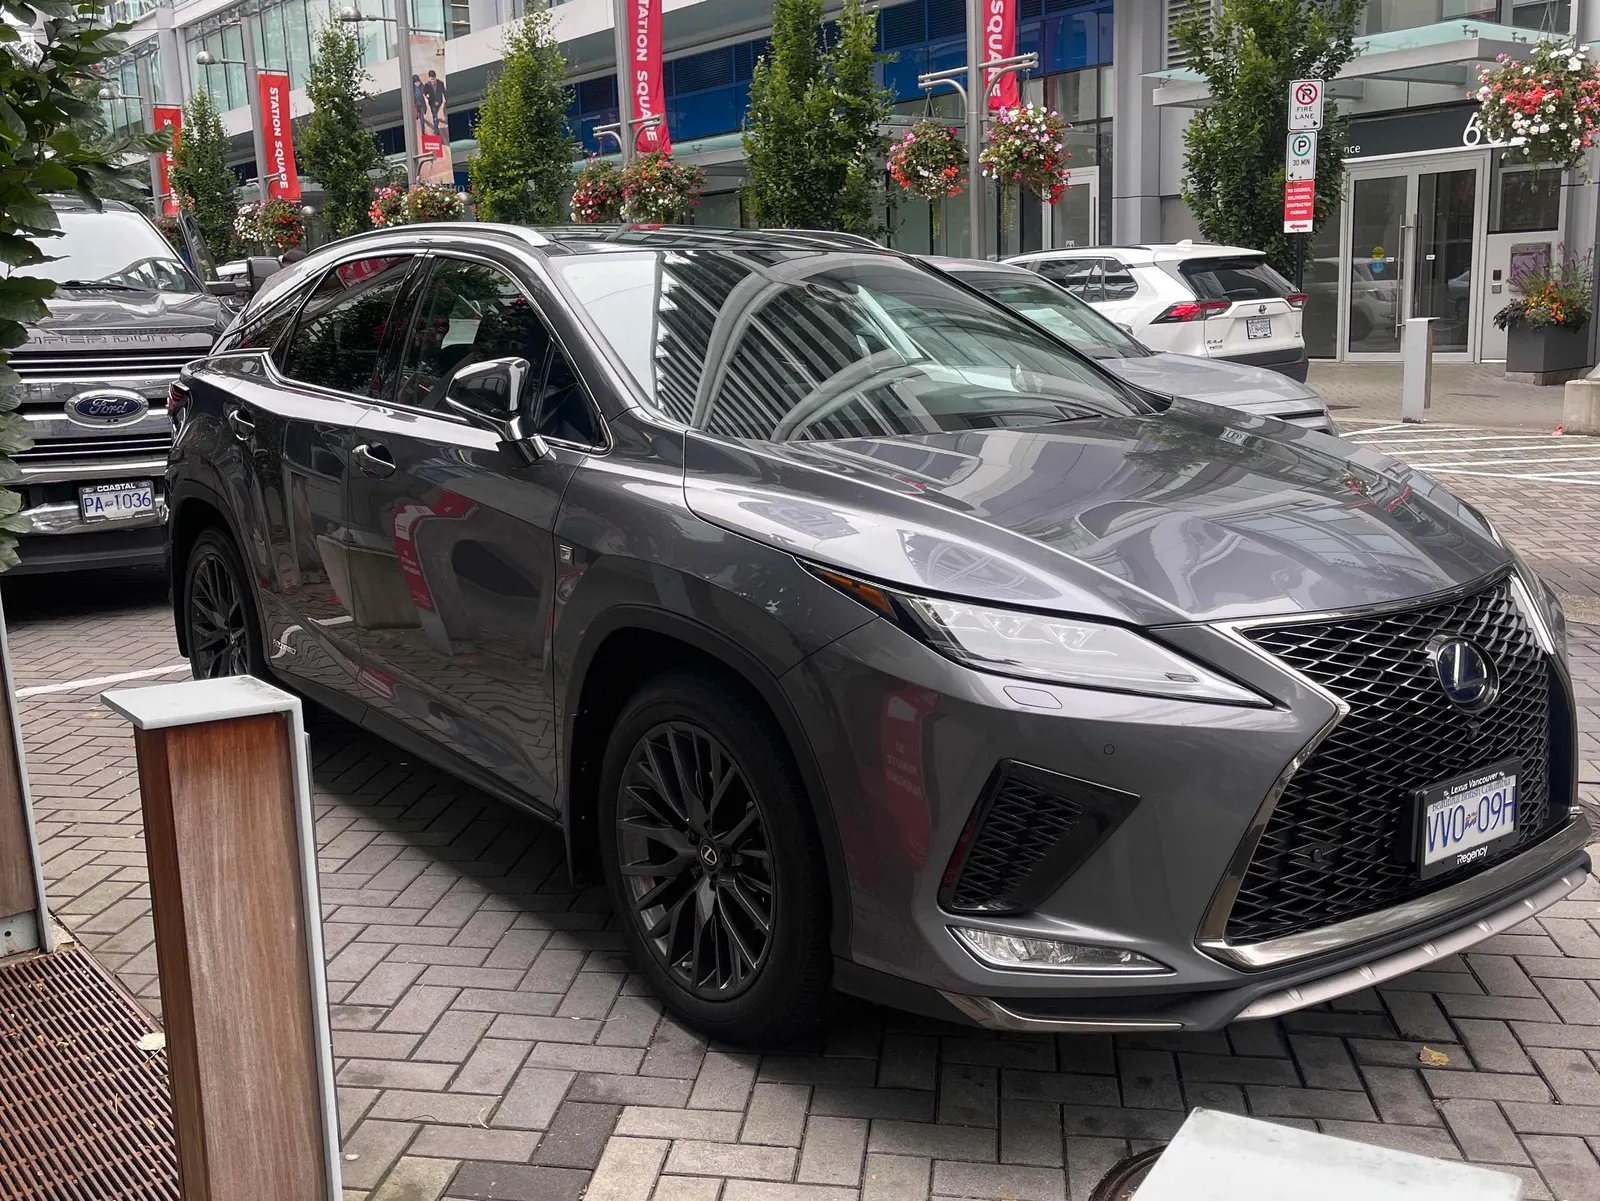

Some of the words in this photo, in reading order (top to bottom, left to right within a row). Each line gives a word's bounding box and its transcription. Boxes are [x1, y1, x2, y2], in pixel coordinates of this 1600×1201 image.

[636, 0, 650, 62] TATION
[269, 87, 282, 137] STATION
[274, 141, 289, 189] SQUARE
[1292, 159, 1299, 167] 30
[28, 336, 108, 345] UPER
[88, 398, 128, 415] Ford
[96, 482, 136, 492] COASTAL
[84, 496, 104, 513] PA
[114, 491, 151, 510] 1036
[1432, 794, 1461, 812] Beautiful
[1461, 788, 1481, 801] British
[1481, 777, 1511, 795] Columbia
[1450, 783, 1468, 795] Lexus
[1468, 771, 1499, 788] Vancouver
[1477, 786, 1516, 834] 09H
[1456, 845, 1489, 865] Regency
